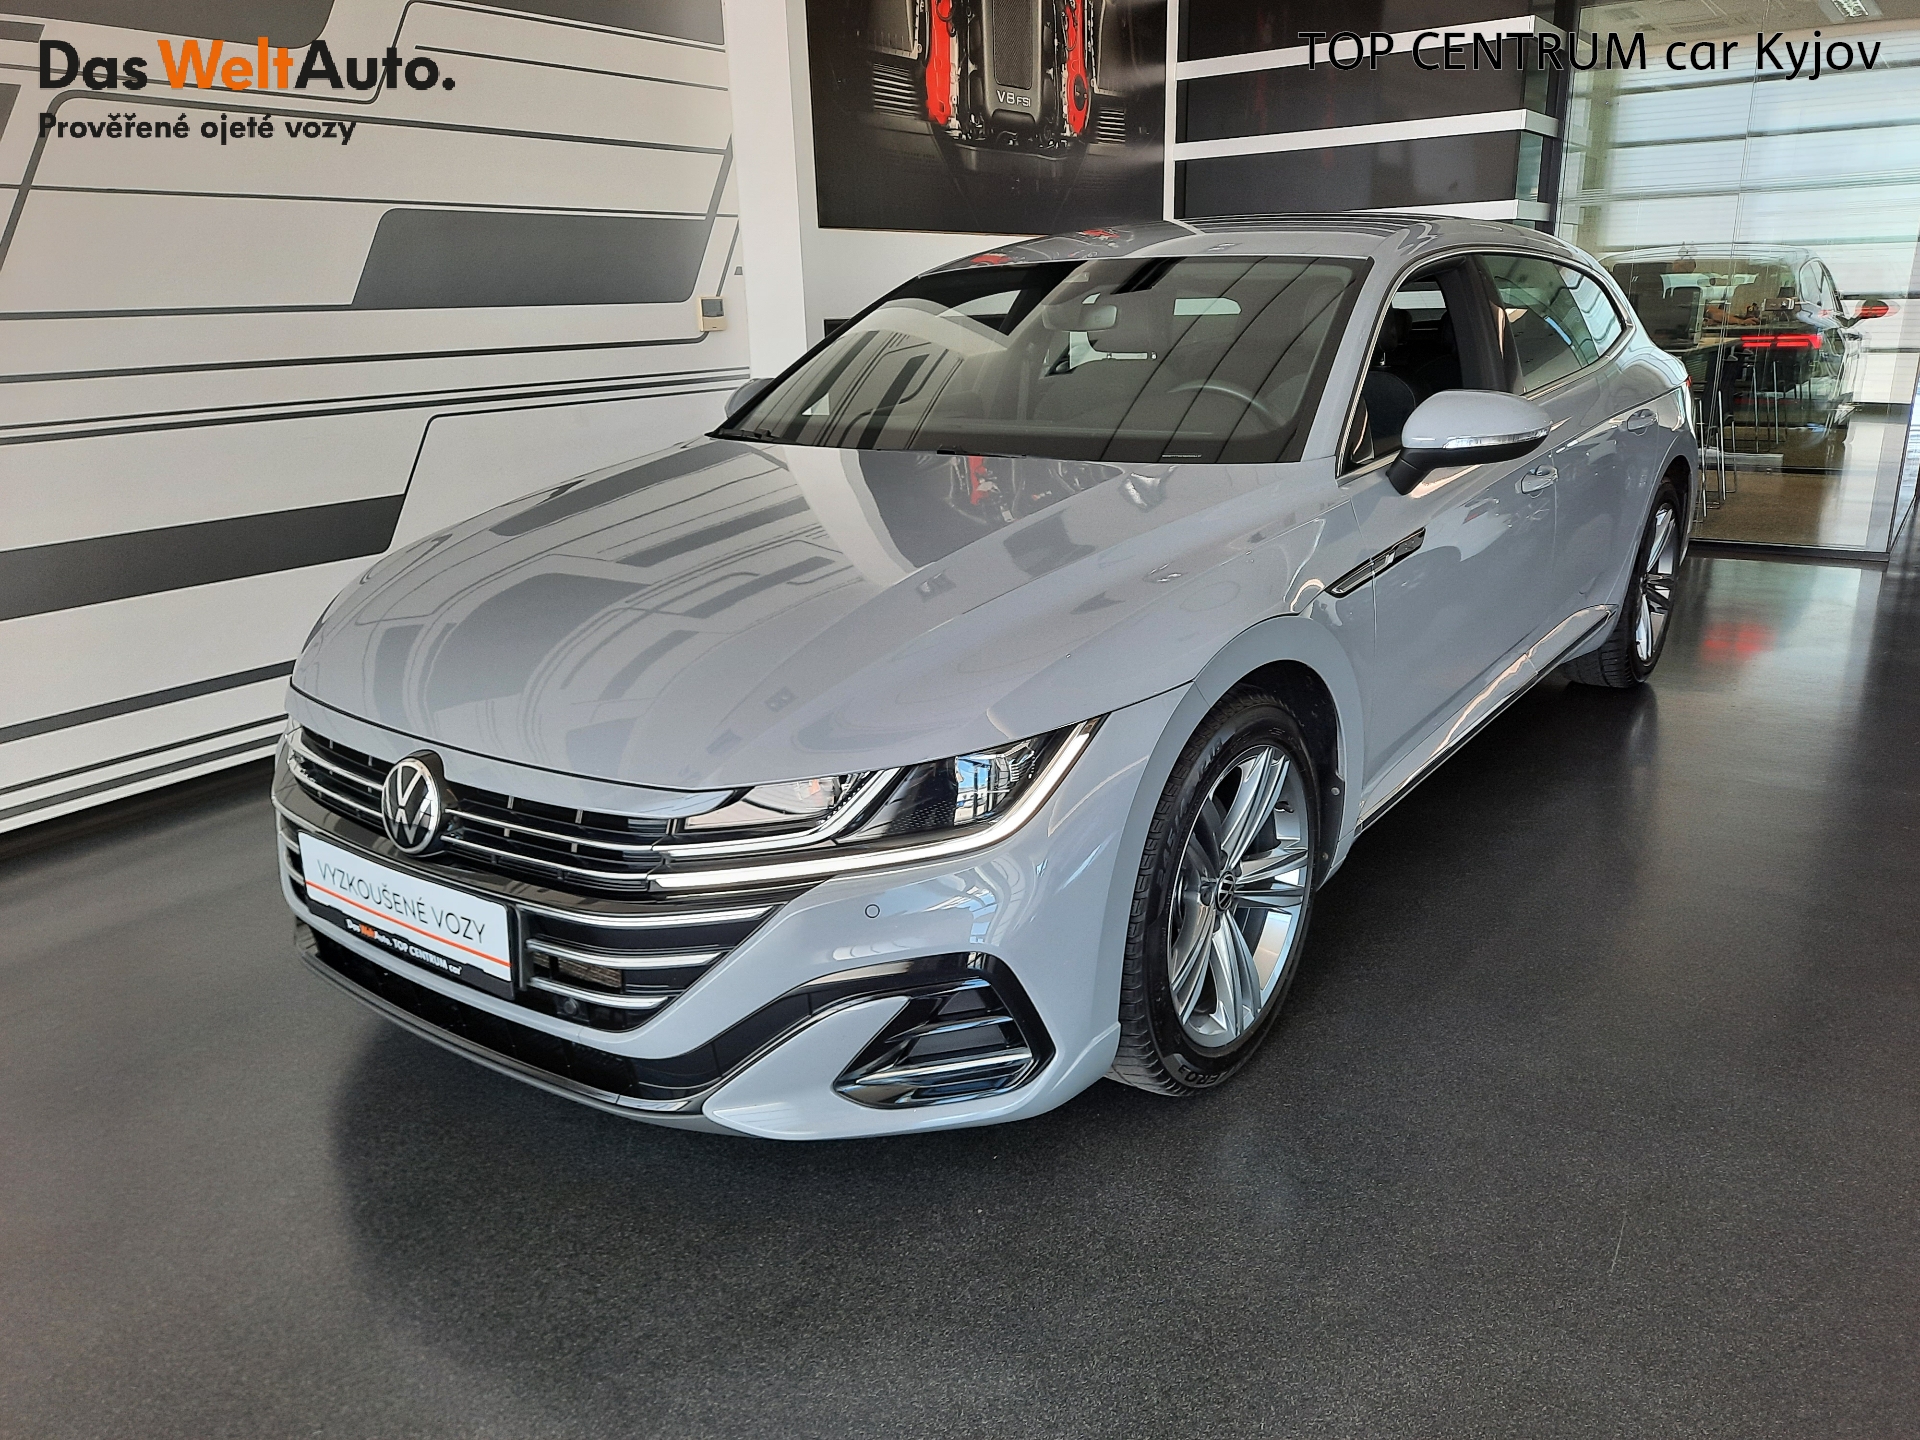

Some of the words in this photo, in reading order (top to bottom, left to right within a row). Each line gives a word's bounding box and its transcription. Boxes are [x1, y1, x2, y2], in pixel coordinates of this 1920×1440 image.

[316, 858, 429, 925] VYZKOUŠENÉ
[431, 905, 486, 944] VOZY
[392, 938, 409, 953] TOP
[409, 945, 448, 971] CENTRUM
